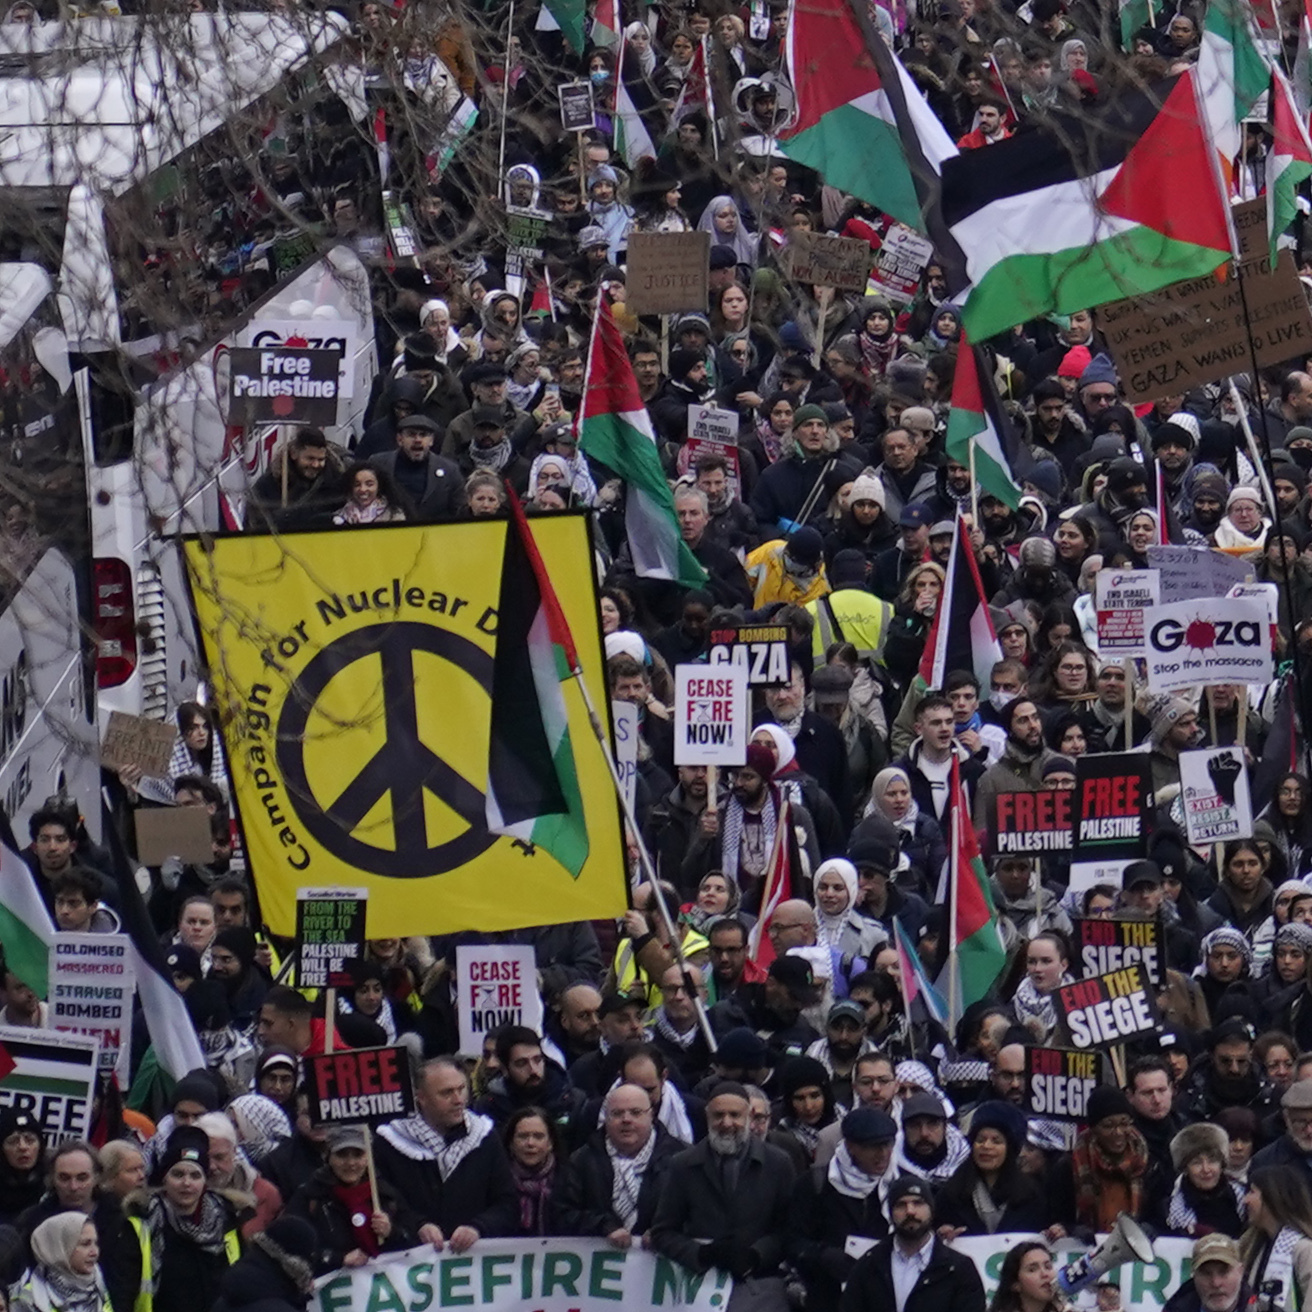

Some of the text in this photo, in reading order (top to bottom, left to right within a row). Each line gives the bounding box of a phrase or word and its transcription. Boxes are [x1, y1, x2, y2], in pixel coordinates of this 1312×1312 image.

[260, 352, 311, 374] Free
[1121, 340, 1174, 366] YEMEN
[234, 374, 336, 398] Palestine
[1131, 361, 1189, 394] GAZA
[314, 578, 470, 628] Nuclear
[1122, 588, 1150, 599] ISRAELI
[261, 616, 312, 673] for
[710, 626, 788, 644] STOP BOMBING
[1149, 619, 1261, 653] Gza
[710, 642, 789, 684] GAZA
[1183, 657, 1263, 668] the massacre
[686, 678, 734, 698] CEASE
[685, 722, 734, 746] NOW!
[247, 682, 313, 874] Campaign
[1081, 776, 1140, 819] FREE
[996, 790, 1073, 831] FREE
[997, 829, 1074, 852] PALESTINE
[1079, 816, 1141, 841] PALESTINE
[303, 901, 358, 916] FROM THE
[302, 915, 352, 930] RIVER TO
[1081, 920, 1156, 948] END THE
[302, 929, 346, 944] THE SEA
[55, 943, 125, 958] COLONISED
[301, 943, 359, 959] PALESTINE
[55, 961, 124, 976] MASSACRED
[300, 958, 329, 973] WILL
[469, 960, 521, 982] CEASE
[1081, 944, 1160, 985] SIEGE
[299, 972, 328, 988] FREE
[1060, 966, 1144, 1013] END THE
[55, 984, 123, 1001] STARVED
[469, 983, 523, 1009] FRE
[55, 1002, 122, 1020] BOMBED
[1066, 990, 1156, 1049] SIEGE
[313, 1050, 402, 1099] FREE
[1031, 1049, 1096, 1079] END THE
[319, 1091, 405, 1121] PALESTINE
